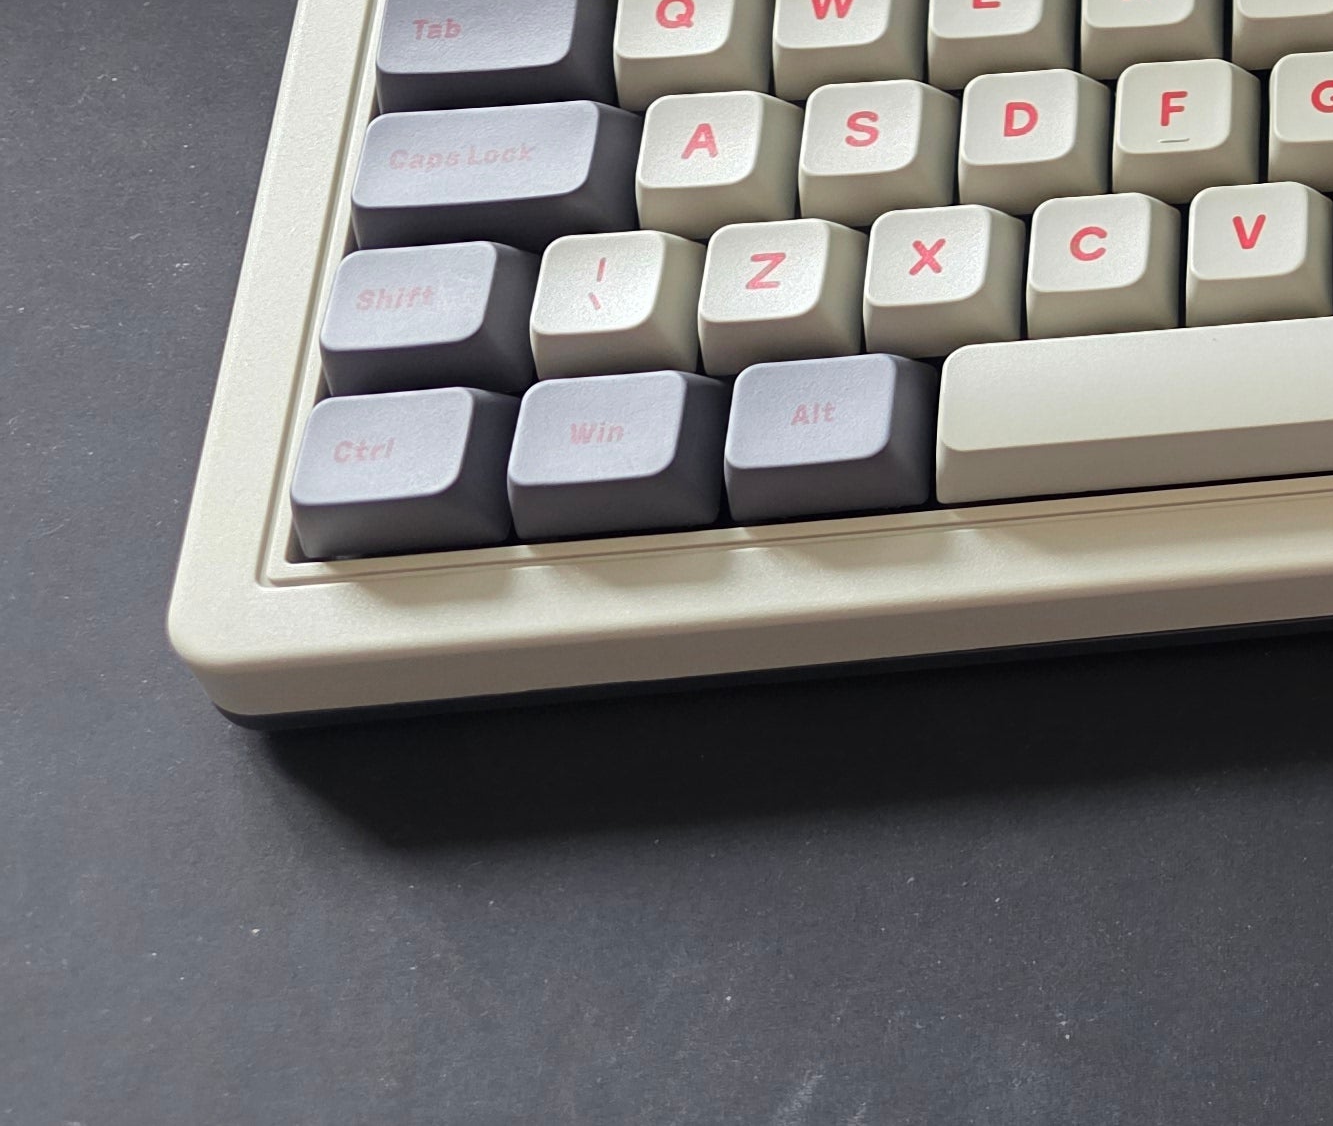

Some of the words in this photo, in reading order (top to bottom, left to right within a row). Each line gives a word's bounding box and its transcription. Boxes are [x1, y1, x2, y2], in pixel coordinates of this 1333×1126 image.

[414, 17, 462, 39] Tab
[1003, 101, 1039, 138] D
[1159, 90, 1188, 127] F
[683, 123, 718, 159] A
[845, 110, 880, 147] S
[389, 149, 461, 171] Caps
[466, 146, 534, 166] Lock
[1069, 225, 1108, 262] C
[1232, 214, 1266, 250] V
[747, 252, 786, 290] Z
[909, 238, 946, 276] X
[356, 285, 435, 311] Shift
[791, 403, 834, 425] Alt
[333, 440, 394, 463] Ctrl
[570, 423, 624, 445] Win
